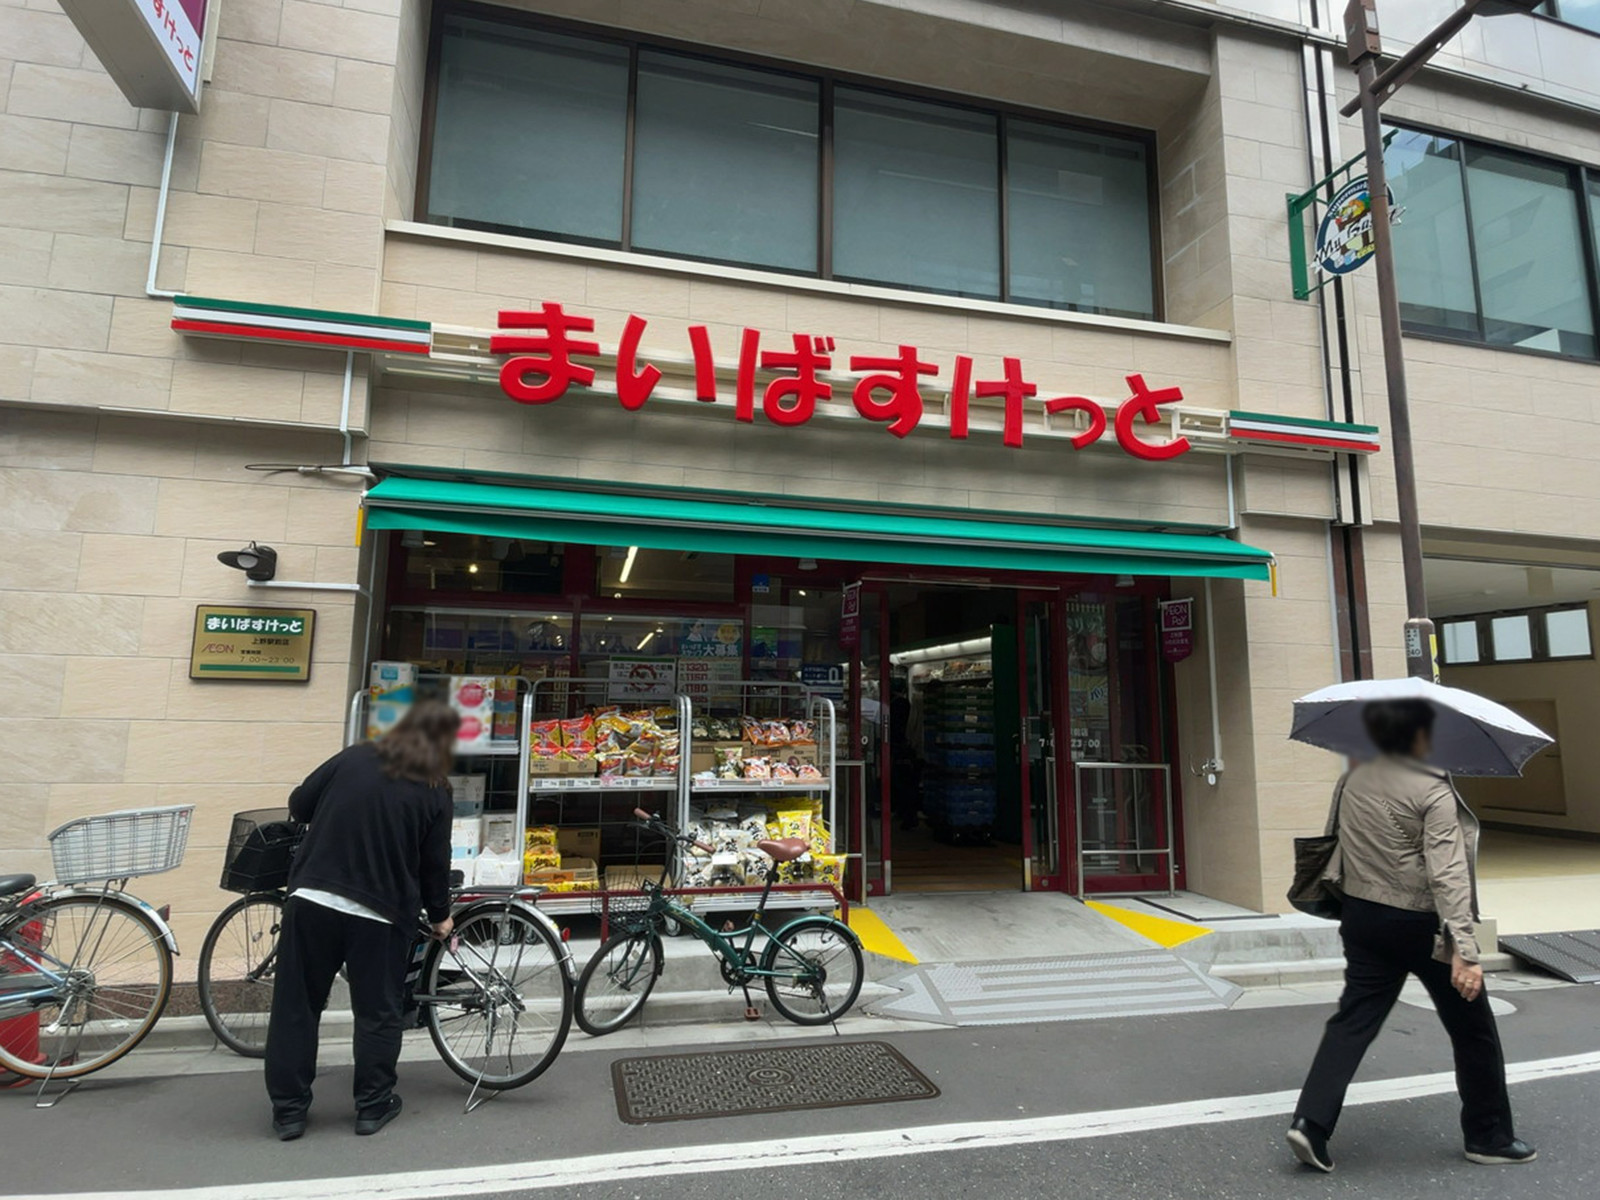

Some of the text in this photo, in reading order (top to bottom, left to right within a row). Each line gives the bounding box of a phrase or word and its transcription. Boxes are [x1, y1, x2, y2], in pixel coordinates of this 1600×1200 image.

[1313, 238, 1342, 262] My
[490, 302, 1192, 461] まいばすけっと
[207, 617, 302, 633] まいばすけっと
